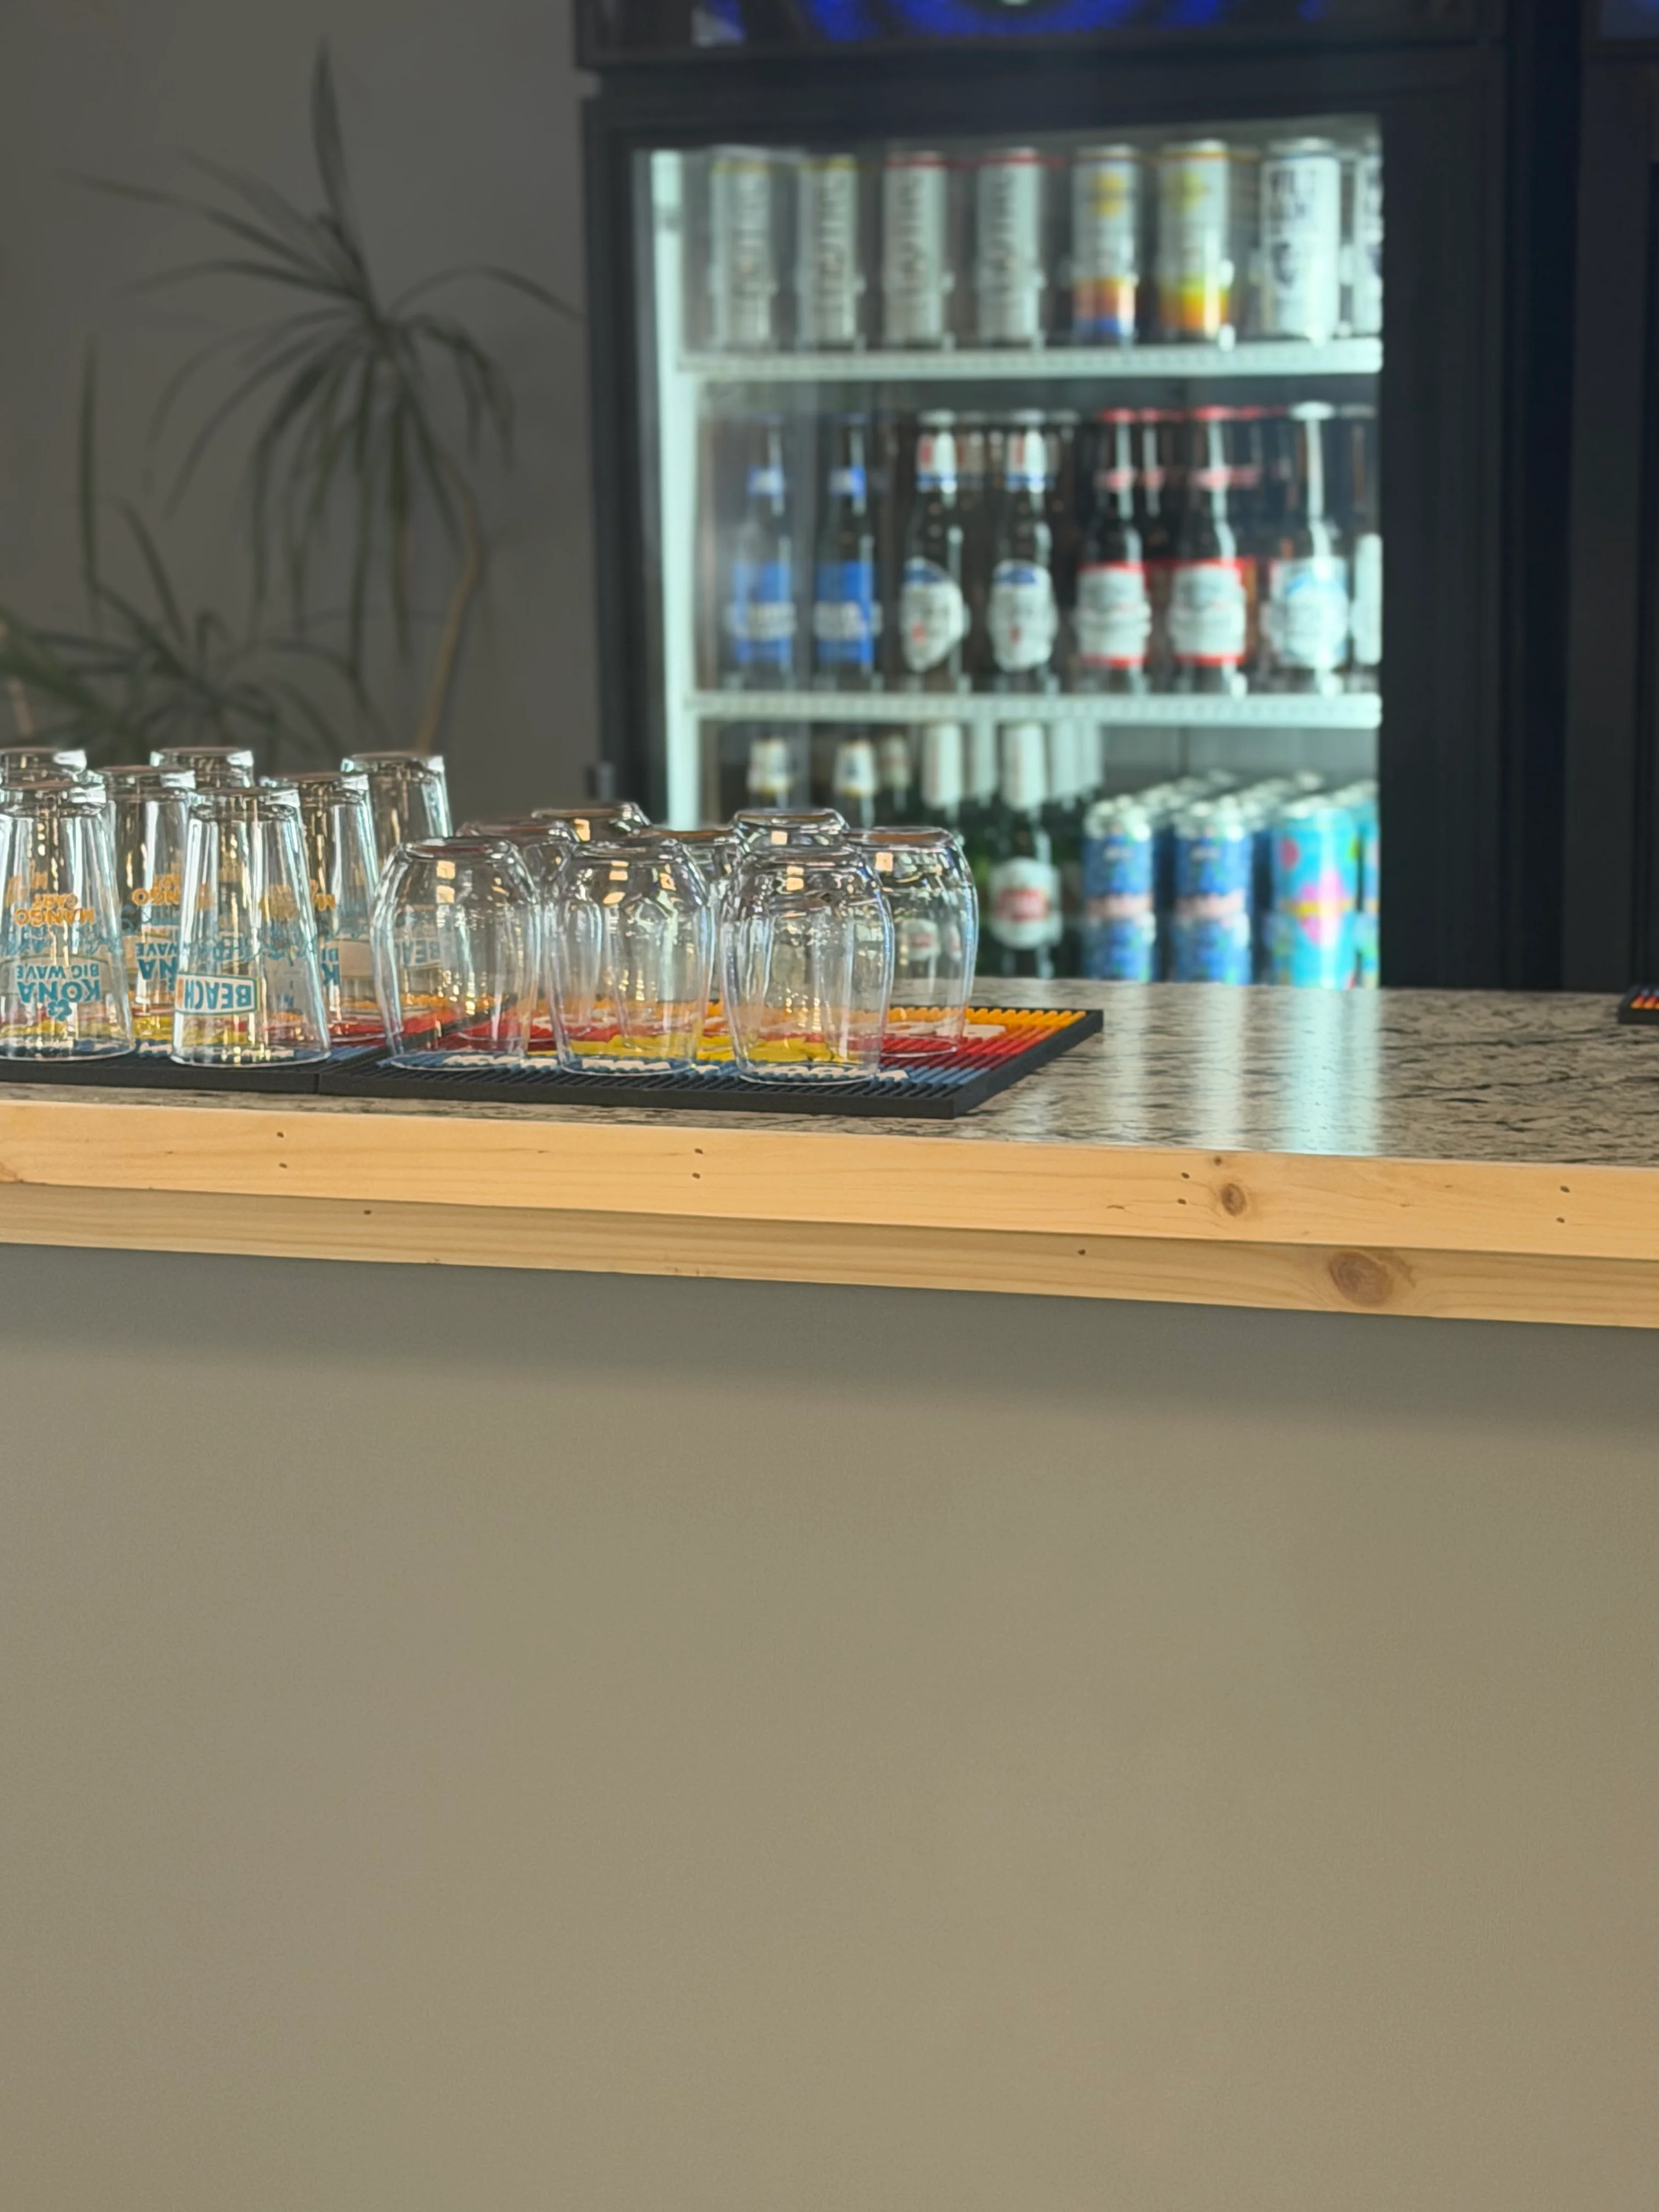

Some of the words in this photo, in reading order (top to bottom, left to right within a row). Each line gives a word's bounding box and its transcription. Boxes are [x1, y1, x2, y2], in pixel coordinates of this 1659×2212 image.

[32, 894, 78, 910] CART
[14, 907, 96, 927] MANGO
[16, 964, 66, 980] WAVE
[70, 963, 100, 980] BIG
[16, 979, 101, 1003] KONA
[184, 979, 252, 1011] BEACH
